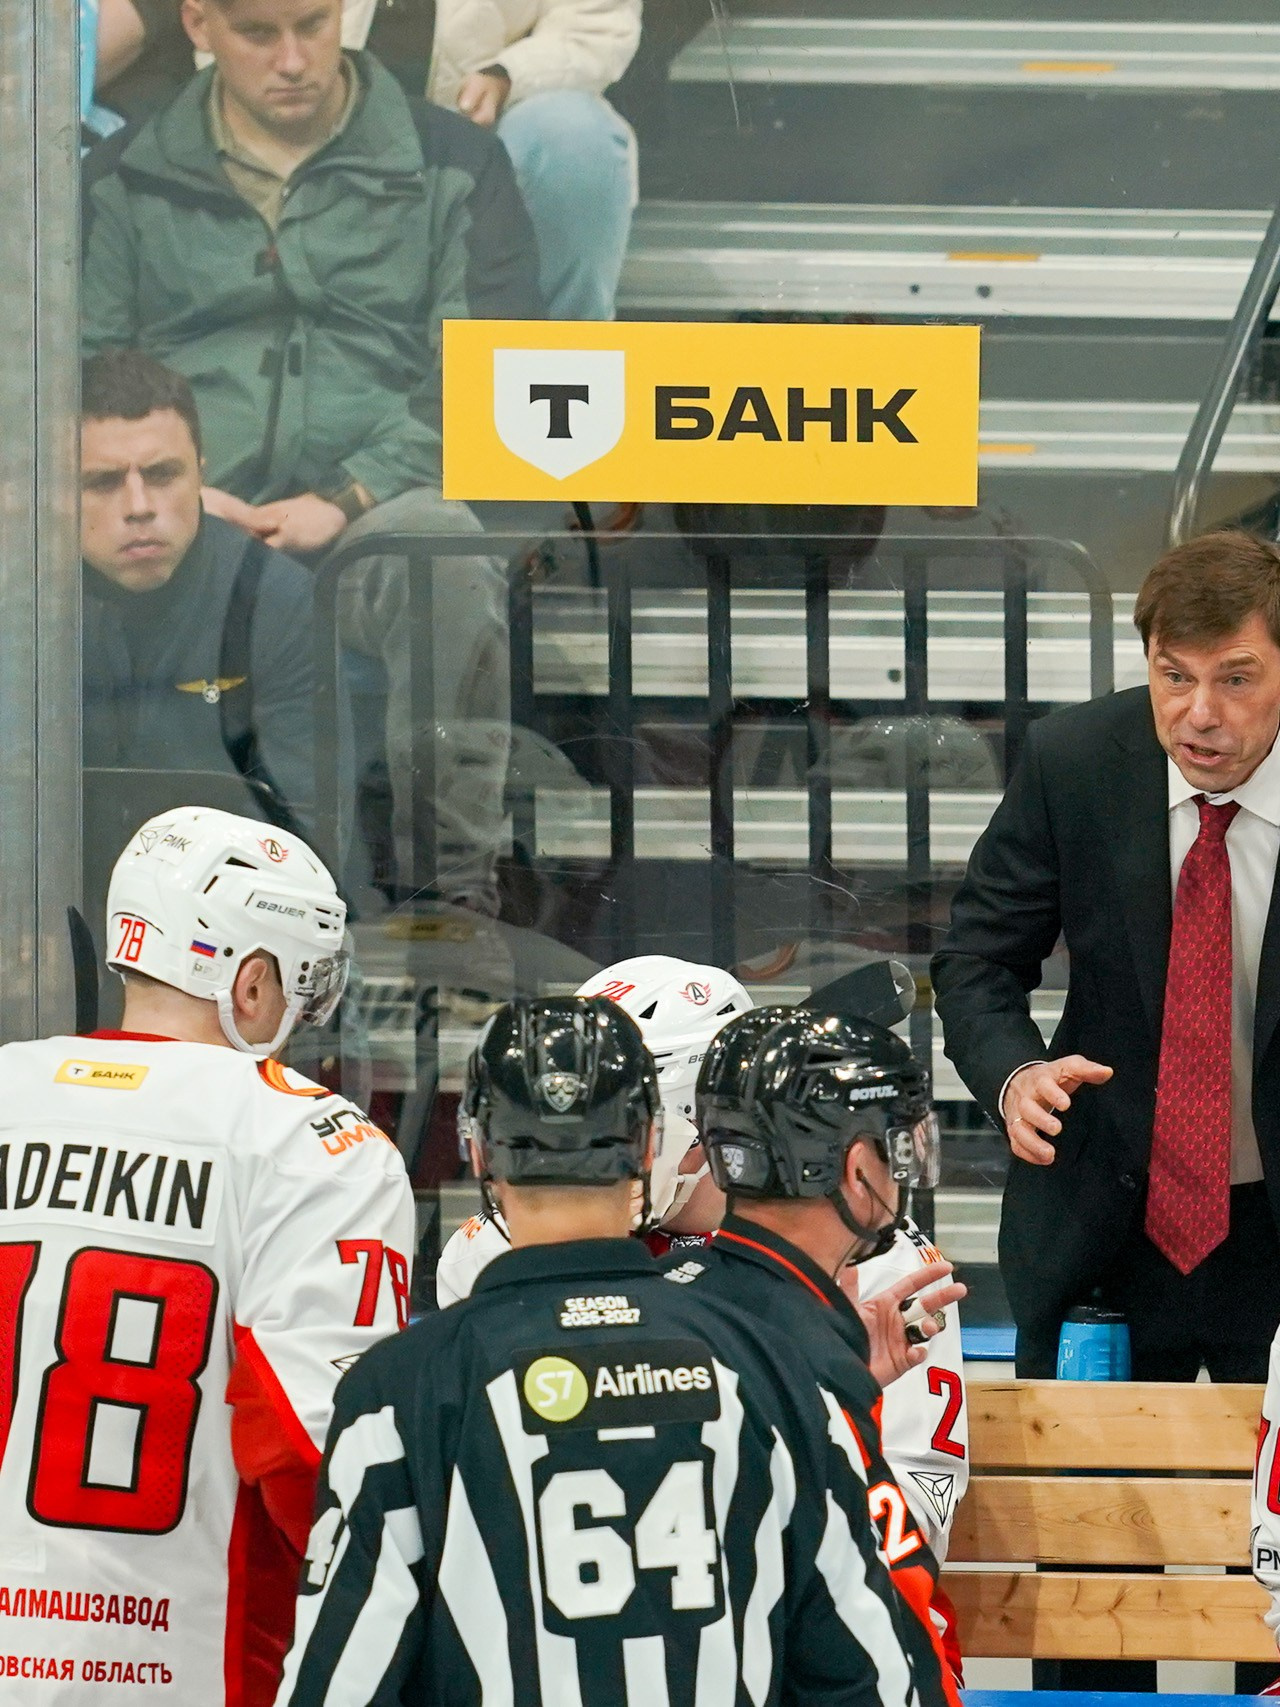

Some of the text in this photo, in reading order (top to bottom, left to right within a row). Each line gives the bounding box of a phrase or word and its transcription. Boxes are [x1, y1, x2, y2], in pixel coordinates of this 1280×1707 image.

[529, 384, 920, 444] Т БАНК
[115, 917, 146, 963] 78
[91, 1070, 136, 1081] БАНК
[310, 1109, 371, 1138] УГМ
[321, 1124, 398, 1156] UMM
[564, 1295, 629, 1312] SEASON
[535, 1370, 575, 1408] S7
[594, 1363, 712, 1398] Airlines
[538, 1460, 717, 1620] 64
[0, 1587, 170, 1632] АЛМАШЗАВОД
[81, 1659, 173, 1685] ОБЛАСТЬ
